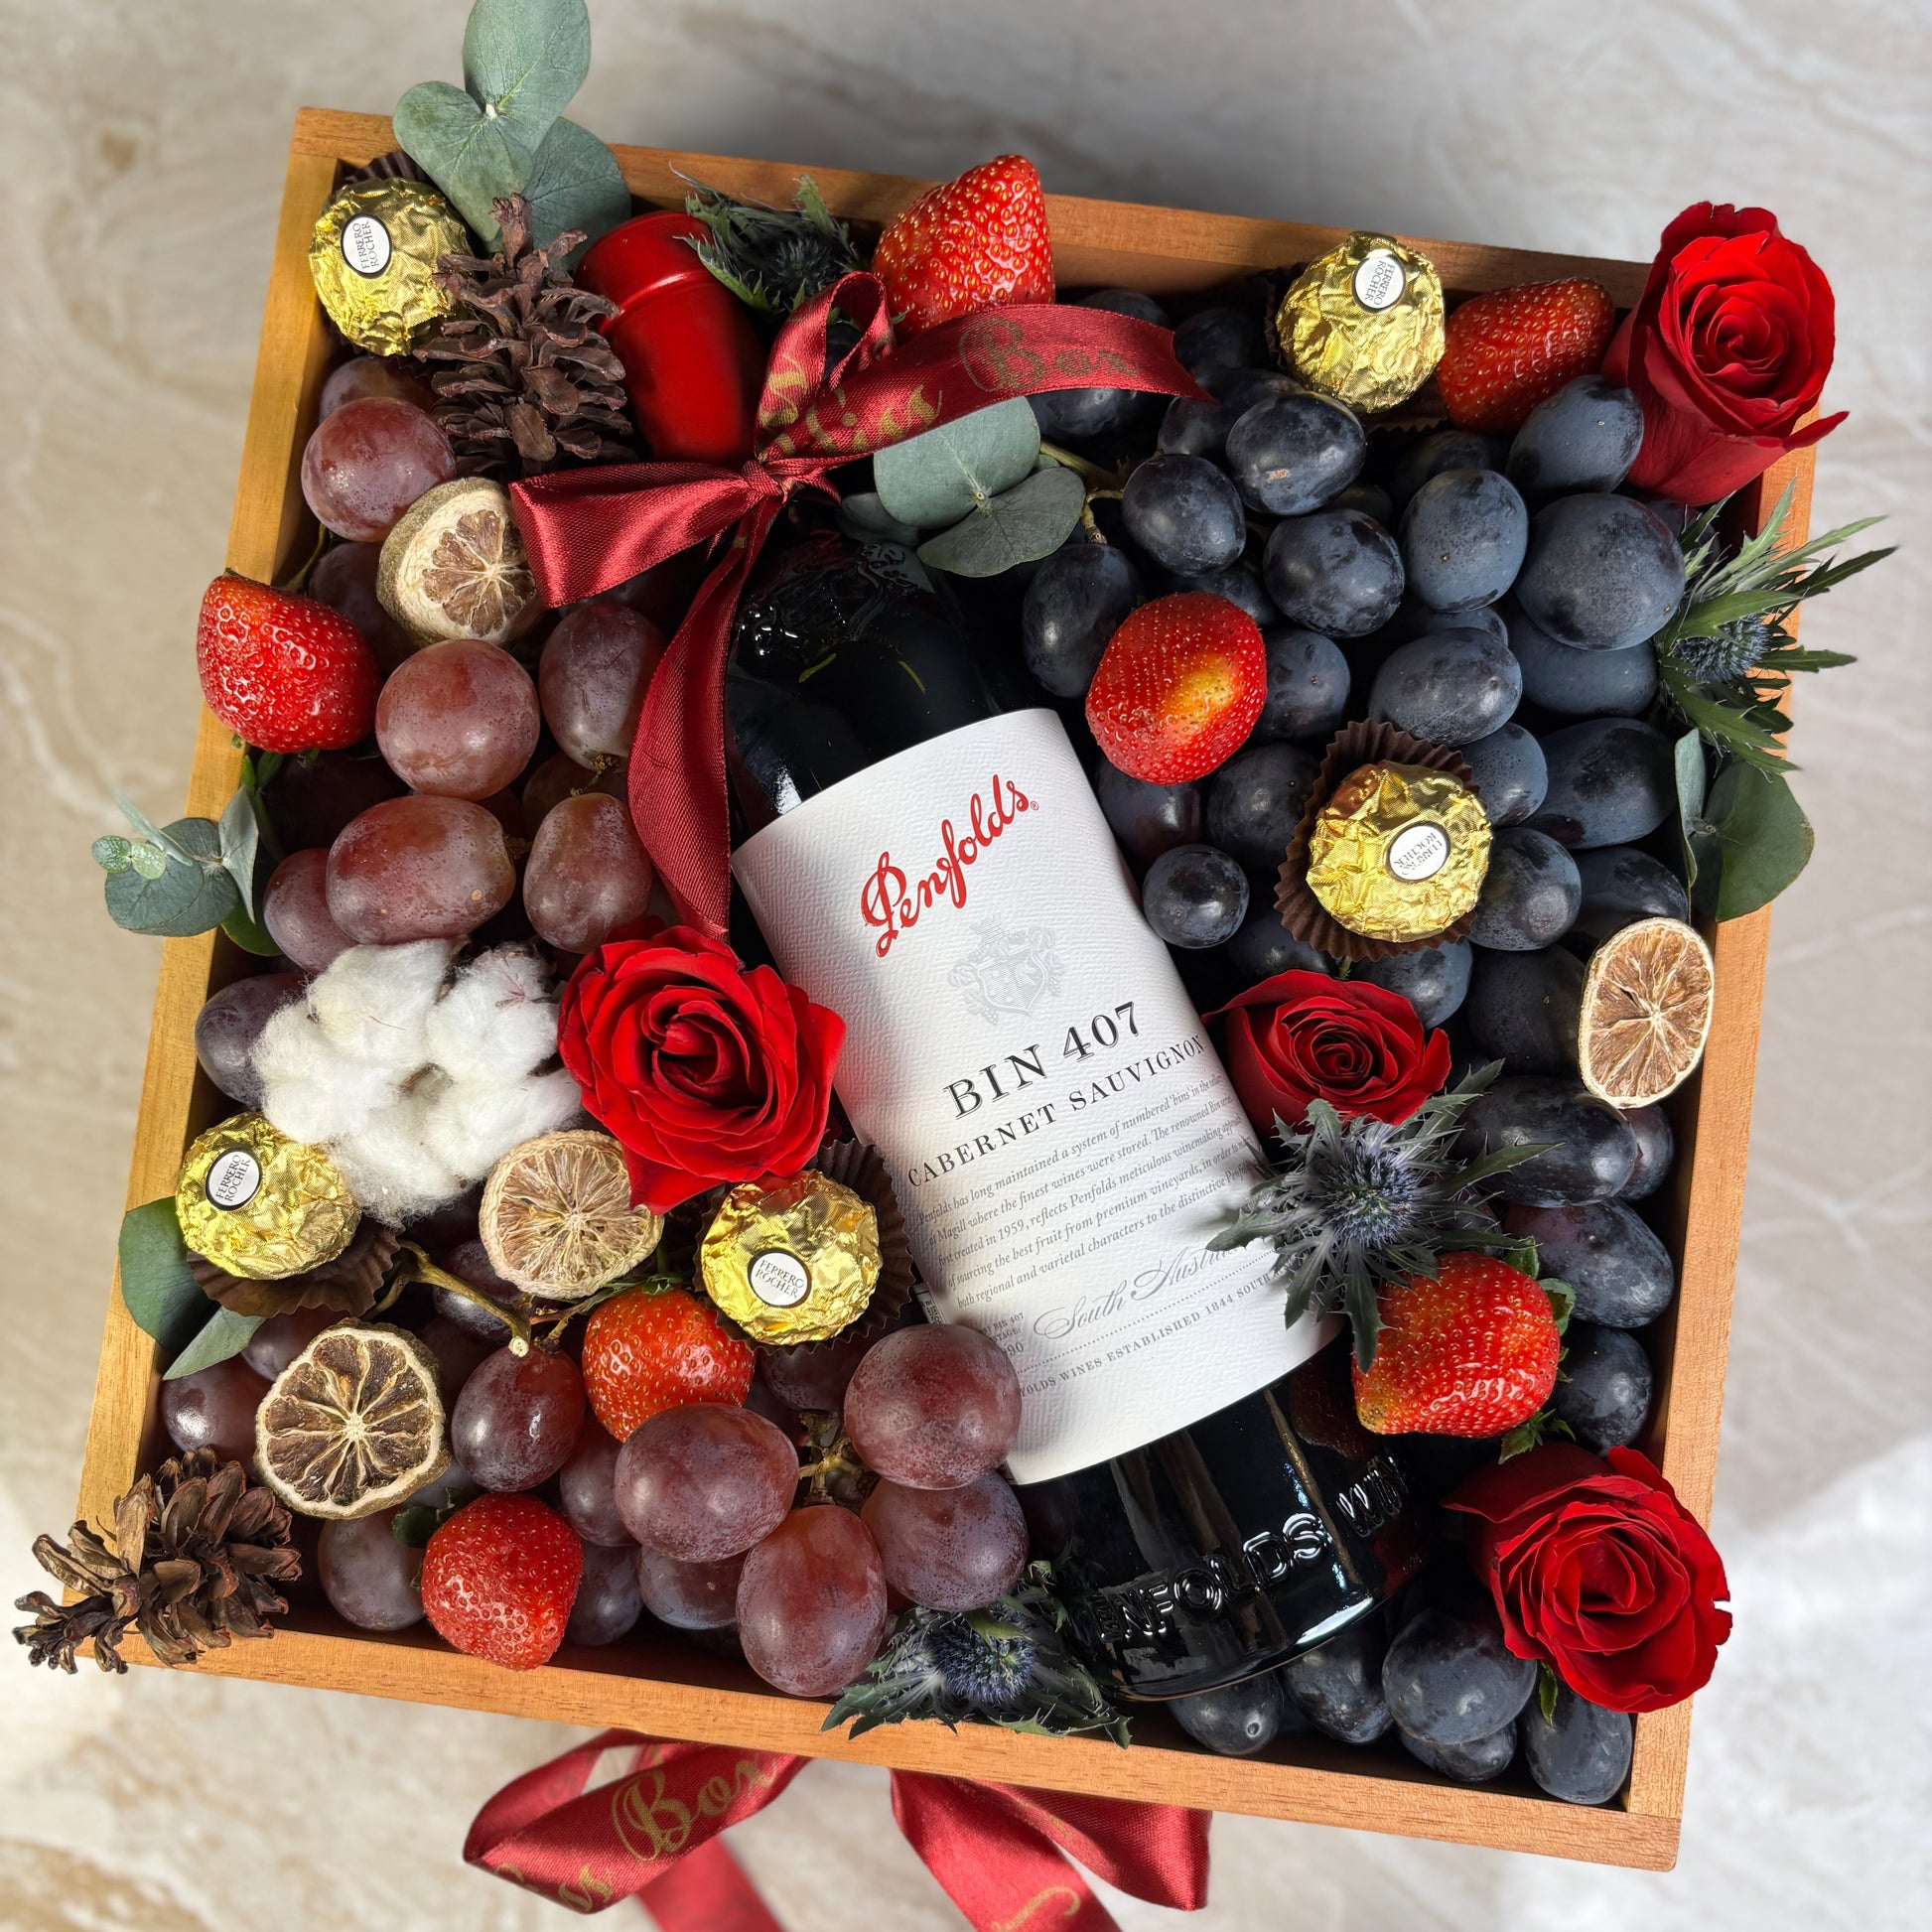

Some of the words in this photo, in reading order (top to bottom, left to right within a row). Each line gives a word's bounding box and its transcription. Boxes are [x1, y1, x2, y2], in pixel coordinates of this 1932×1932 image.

[352, 222, 370, 269] FERRERO
[361, 220, 380, 267] ROCHER
[1363, 260, 1387, 301] ROCHER
[1373, 263, 1396, 306] FERRERO
[958, 316, 1141, 395] Box
[861, 773, 1031, 958] Penfolds
[942, 1043, 1047, 1121] BIN
[1062, 1001, 1141, 1063] 407
[907, 1102, 1057, 1187] CABERNET
[1069, 1035, 1207, 1112] SAUVIGNON
[215, 1155, 242, 1199] FERRERO
[224, 1159, 251, 1202] ROCHER
[918, 1201, 952, 1225] Penfolds
[952, 1196, 969, 1209] has
[970, 1186, 994, 1201] long
[995, 1150, 1059, 1192] maintained
[1061, 1151, 1069, 1160] a
[1071, 1130, 1107, 1158] system
[1109, 1120, 1121, 1140] of
[1122, 1097, 1171, 1131] numbered
[1190, 1084, 1200, 1097] in
[1200, 1080, 1211, 1092] the
[937, 1218, 967, 1243] Magill
[968, 1207, 998, 1228] where
[1000, 1199, 1018, 1213] the
[1018, 1181, 1049, 1211] finest
[1051, 1168, 1085, 1190] wines
[1087, 1154, 1115, 1173] were
[1117, 1134, 1152, 1160] stored.
[1151, 1125, 1170, 1142] The
[1171, 1104, 1210, 1134] renowned
[1208, 1100, 1222, 1114] Bin
[937, 1253, 954, 1271] first
[954, 1238, 984, 1260] created
[986, 1234, 998, 1247] in
[999, 1218, 1030, 1241] 1959,
[1030, 1200, 1068, 1227] reflects
[1068, 1176, 1117, 1207] Penfolds
[1119, 1151, 1174, 1184] meticulous
[1173, 1125, 1224, 1158] winemaking
[948, 1274, 956, 1291] of
[956, 1261, 995, 1285] sourcing
[995, 1251, 1011, 1268] the
[1012, 1242, 1034, 1261] best
[1035, 1230, 1063, 1255] fruit
[1064, 1219, 1093, 1242] from
[1095, 1189, 1148, 1227] premium
[1149, 1163, 1202, 1195] vineyards,
[1201, 1159, 1212, 1170] in
[1212, 1147, 1232, 1165] order
[759, 1259, 804, 1289] FERRERO
[956, 1296, 975, 1310] both
[976, 1275, 1015, 1303] regional
[1016, 1266, 1038, 1285] and
[1038, 1243, 1085, 1274] varietal
[1087, 1218, 1145, 1253] characters
[1147, 1211, 1158, 1225] to
[1160, 1202, 1176, 1218] the
[1177, 1178, 1226, 1210] distinctive
[756, 1269, 798, 1299] ROCHER
[993, 1318, 1009, 1331] BIN
[1009, 1311, 1025, 1324] 407
[1034, 1279, 1127, 1339] South
[1059, 1357, 1103, 1382] WINES
[1106, 1311, 1201, 1363] ESTABLISHED
[1205, 1294, 1234, 1315] 1844
[1236, 1271, 1272, 1299] SOUTH
[611, 1751, 778, 1863] Box
